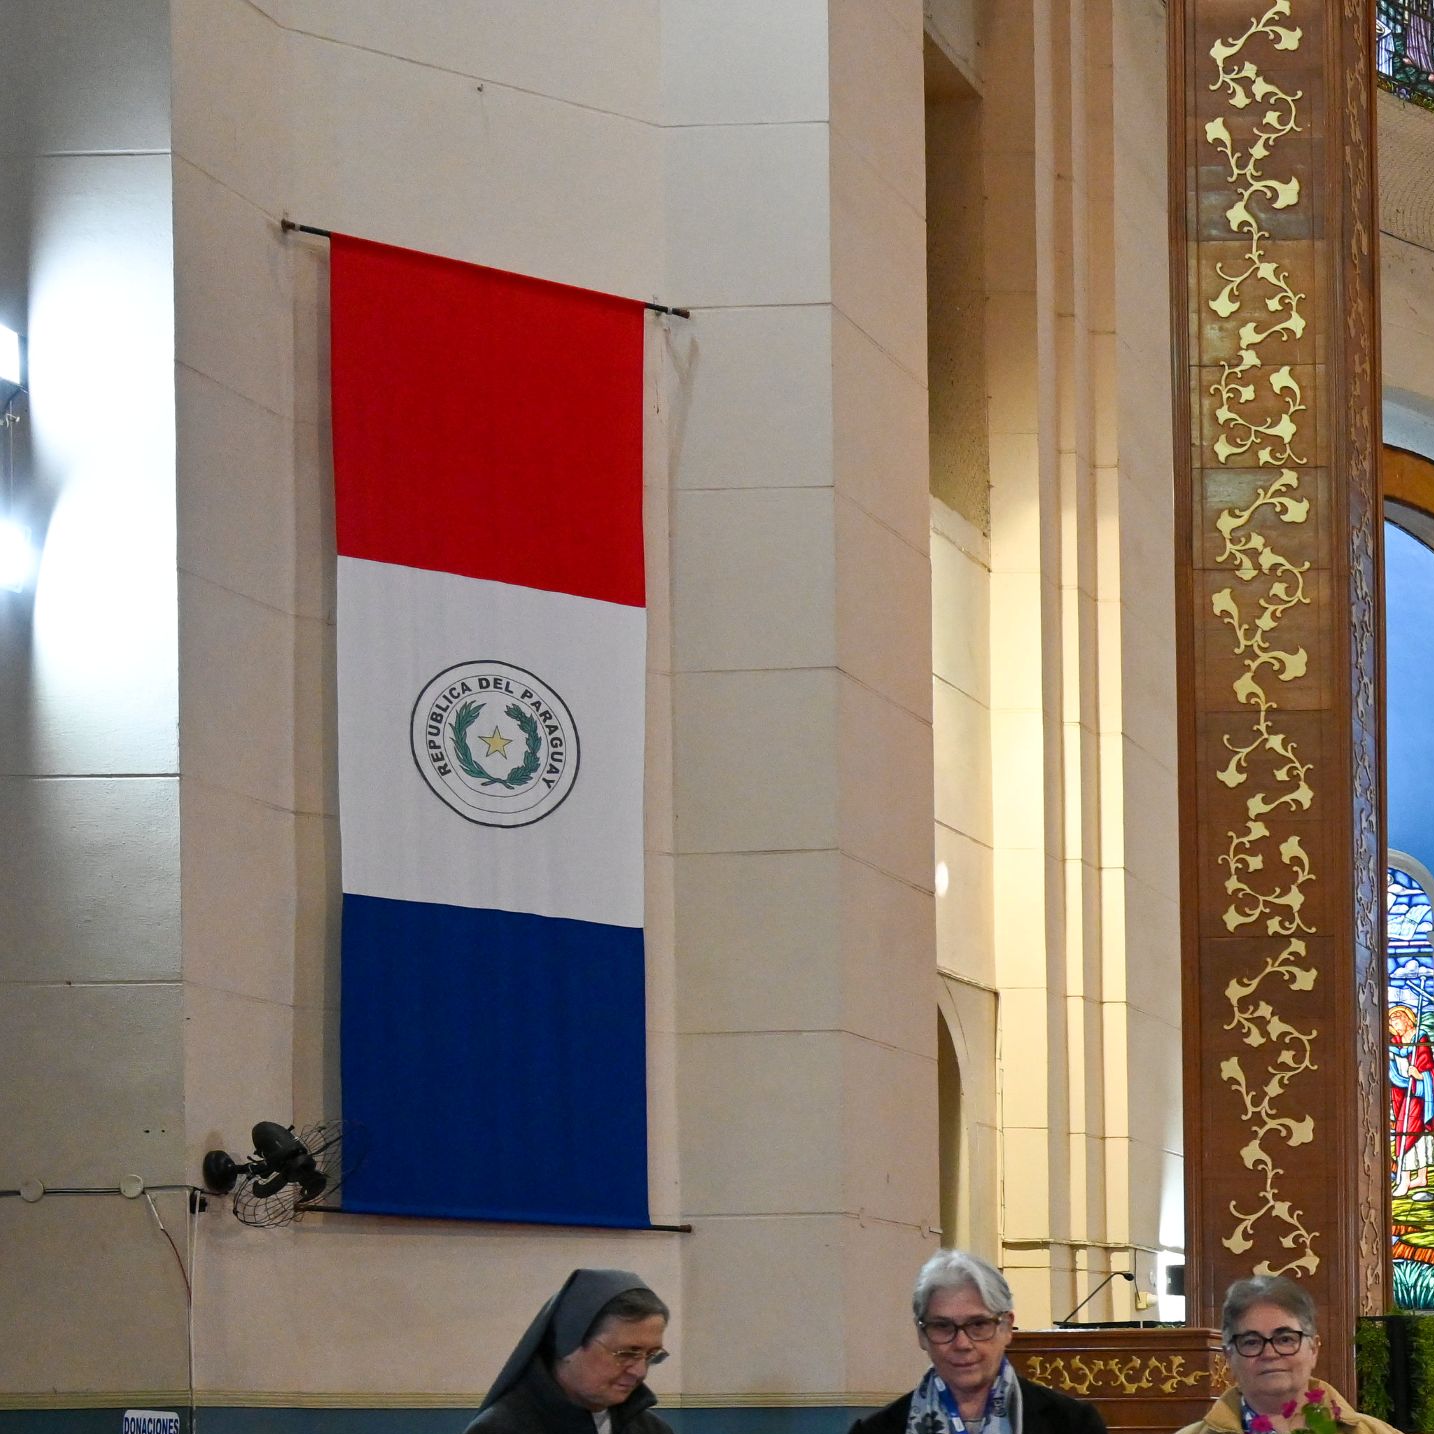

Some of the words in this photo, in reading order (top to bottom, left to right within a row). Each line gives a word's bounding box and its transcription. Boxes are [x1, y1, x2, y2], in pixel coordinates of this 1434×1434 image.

[428, 681, 472, 777] REPUBLICA
[477, 677, 515, 694] DEL
[520, 690, 564, 790] PARAGUAY
